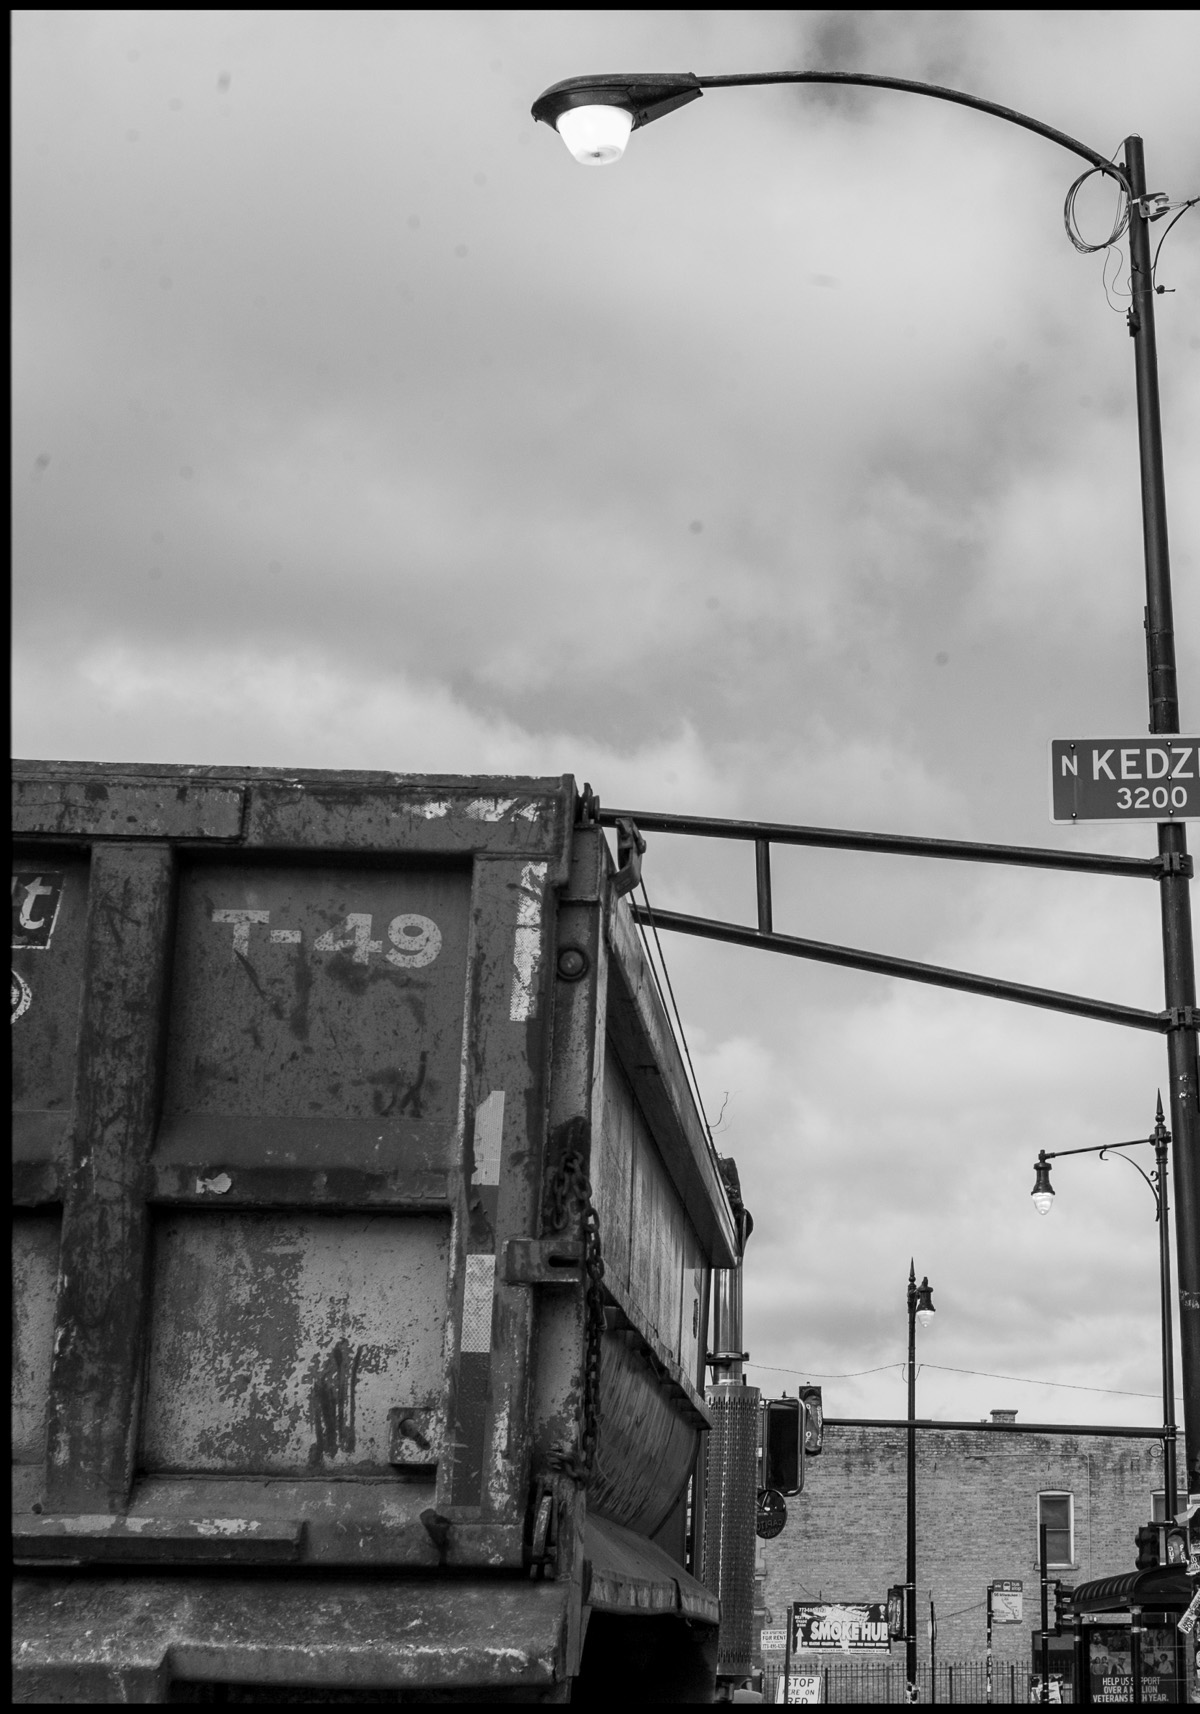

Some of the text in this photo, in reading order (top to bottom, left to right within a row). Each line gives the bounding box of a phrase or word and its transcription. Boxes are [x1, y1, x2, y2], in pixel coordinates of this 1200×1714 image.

[1061, 755, 1078, 777] N
[1116, 786, 1188, 809] 3200
[211, 908, 443, 969] T-49
[810, 1621, 889, 1641] SMOKE HUB
[787, 1677, 815, 1688] STOP
[1102, 1676, 1120, 1686] HELP
[1120, 1676, 1130, 1686] US
[1103, 1685, 1122, 1694] OVER
[1123, 1685, 1129, 1694] A
[1092, 1694, 1129, 1703] VETERANS
[1129, 1694, 1148, 1703] EH
